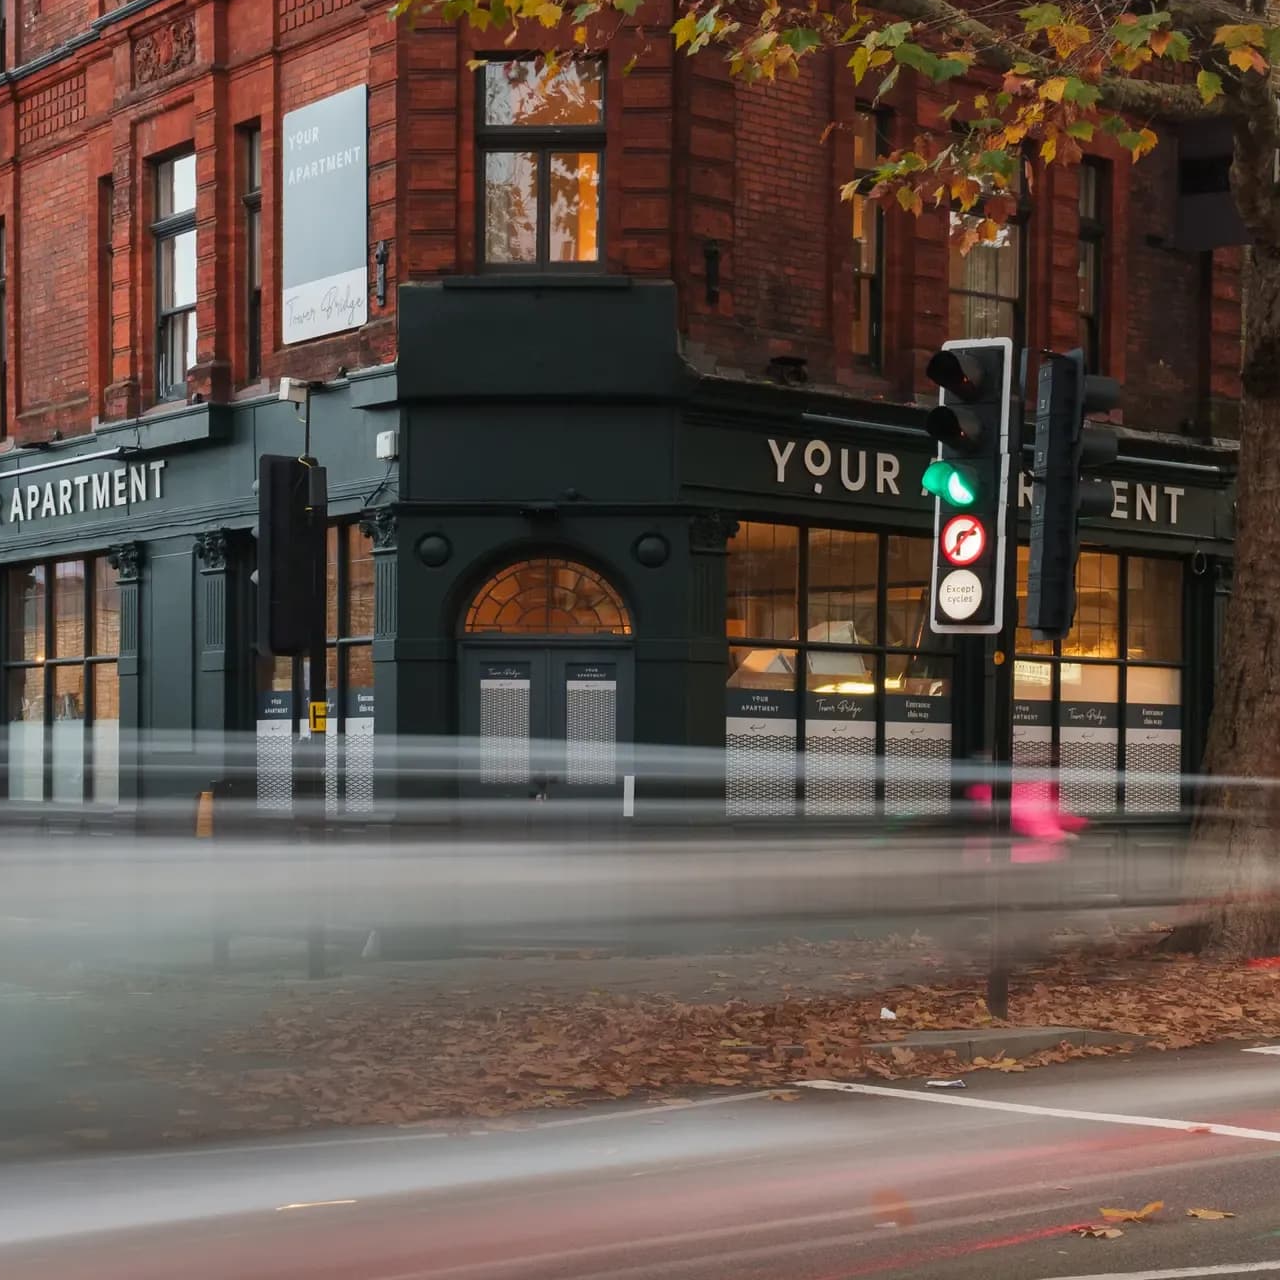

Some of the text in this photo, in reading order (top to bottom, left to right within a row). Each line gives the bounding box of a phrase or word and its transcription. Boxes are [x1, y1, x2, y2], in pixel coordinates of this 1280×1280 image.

[288, 126, 320, 152] YOUR
[288, 146, 362, 186] APARTMENT
[320, 284, 365, 326] Bridge
[767, 438, 901, 496] YOUR
[9, 459, 167, 523] APARTMENT
[946, 584, 975, 594] Except
[947, 595, 973, 605] cycles
[752, 695, 769, 704] YOUR
[905, 700, 931, 709] Entrance
[741, 705, 780, 713] APARTMENT
